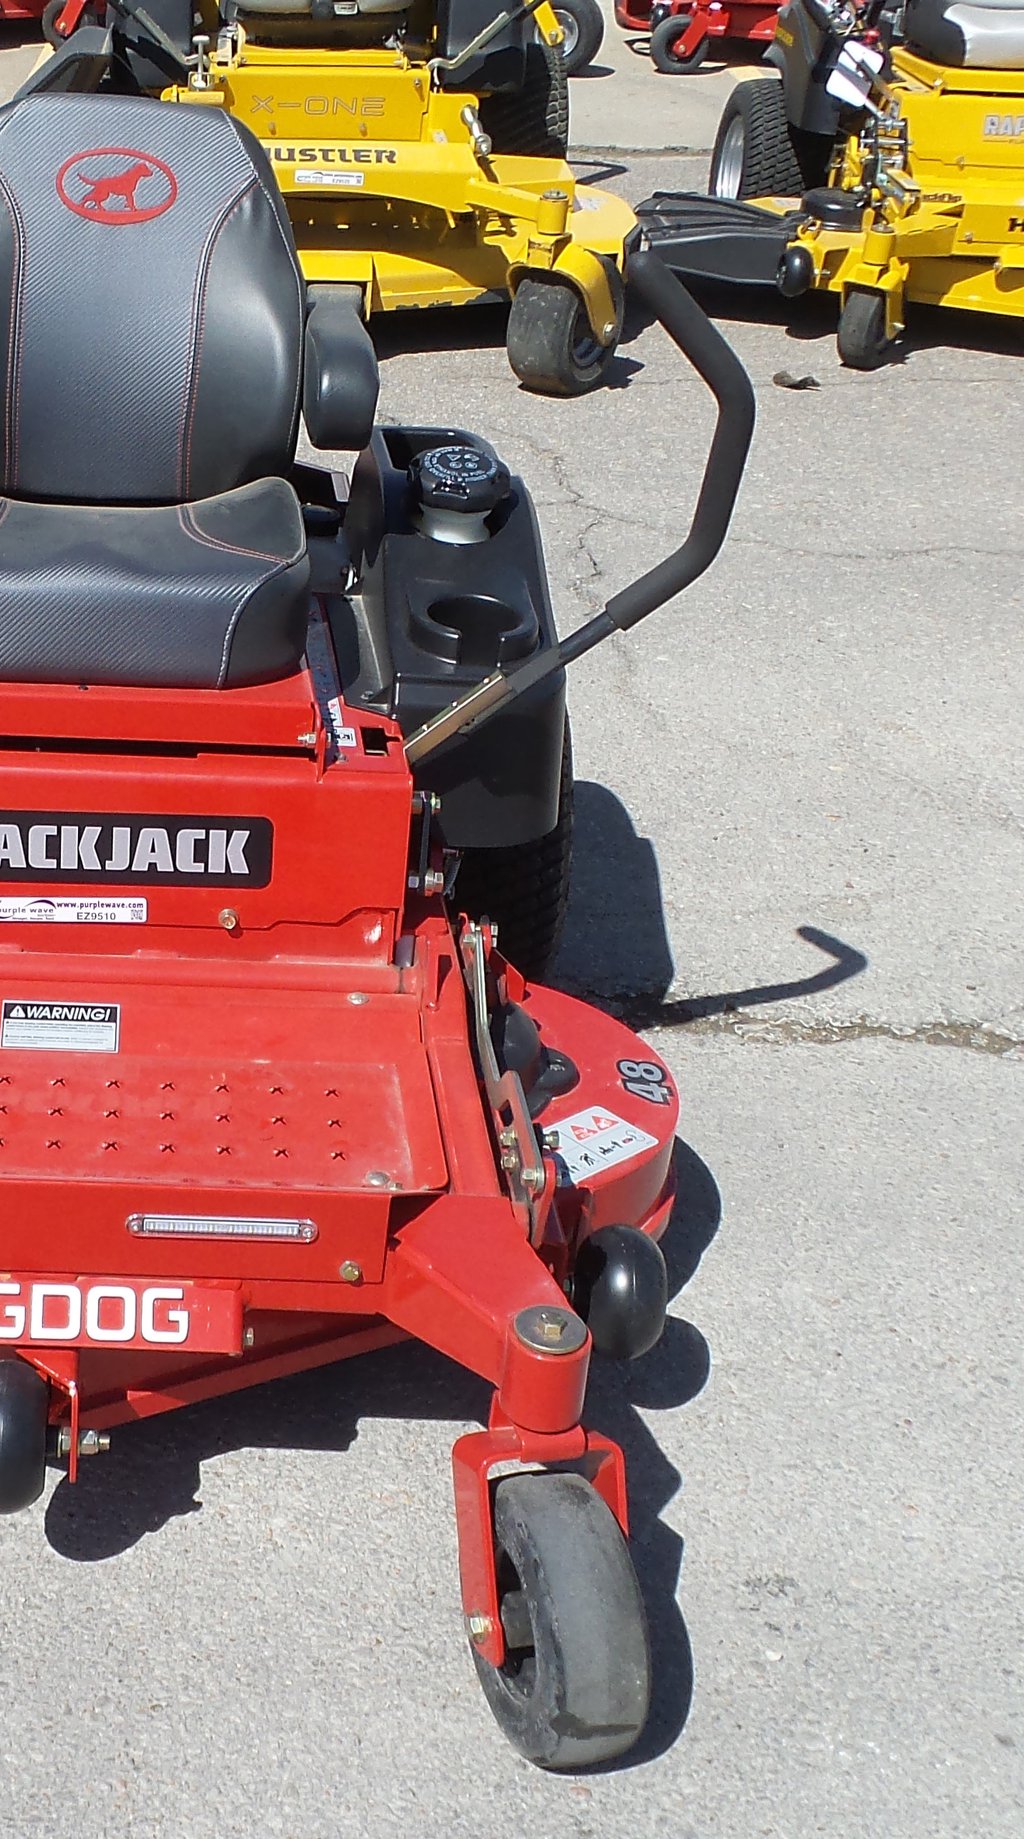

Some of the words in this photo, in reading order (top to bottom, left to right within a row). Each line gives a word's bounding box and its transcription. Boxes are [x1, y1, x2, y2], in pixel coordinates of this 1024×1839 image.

[251, 95, 386, 116] X-ONE
[56, 901, 144, 910] www.purplewave.com
[76, 911, 117, 921] EZ9510
[26, 1005, 111, 1021] WARNING!
[617, 1059, 674, 1105] 48
